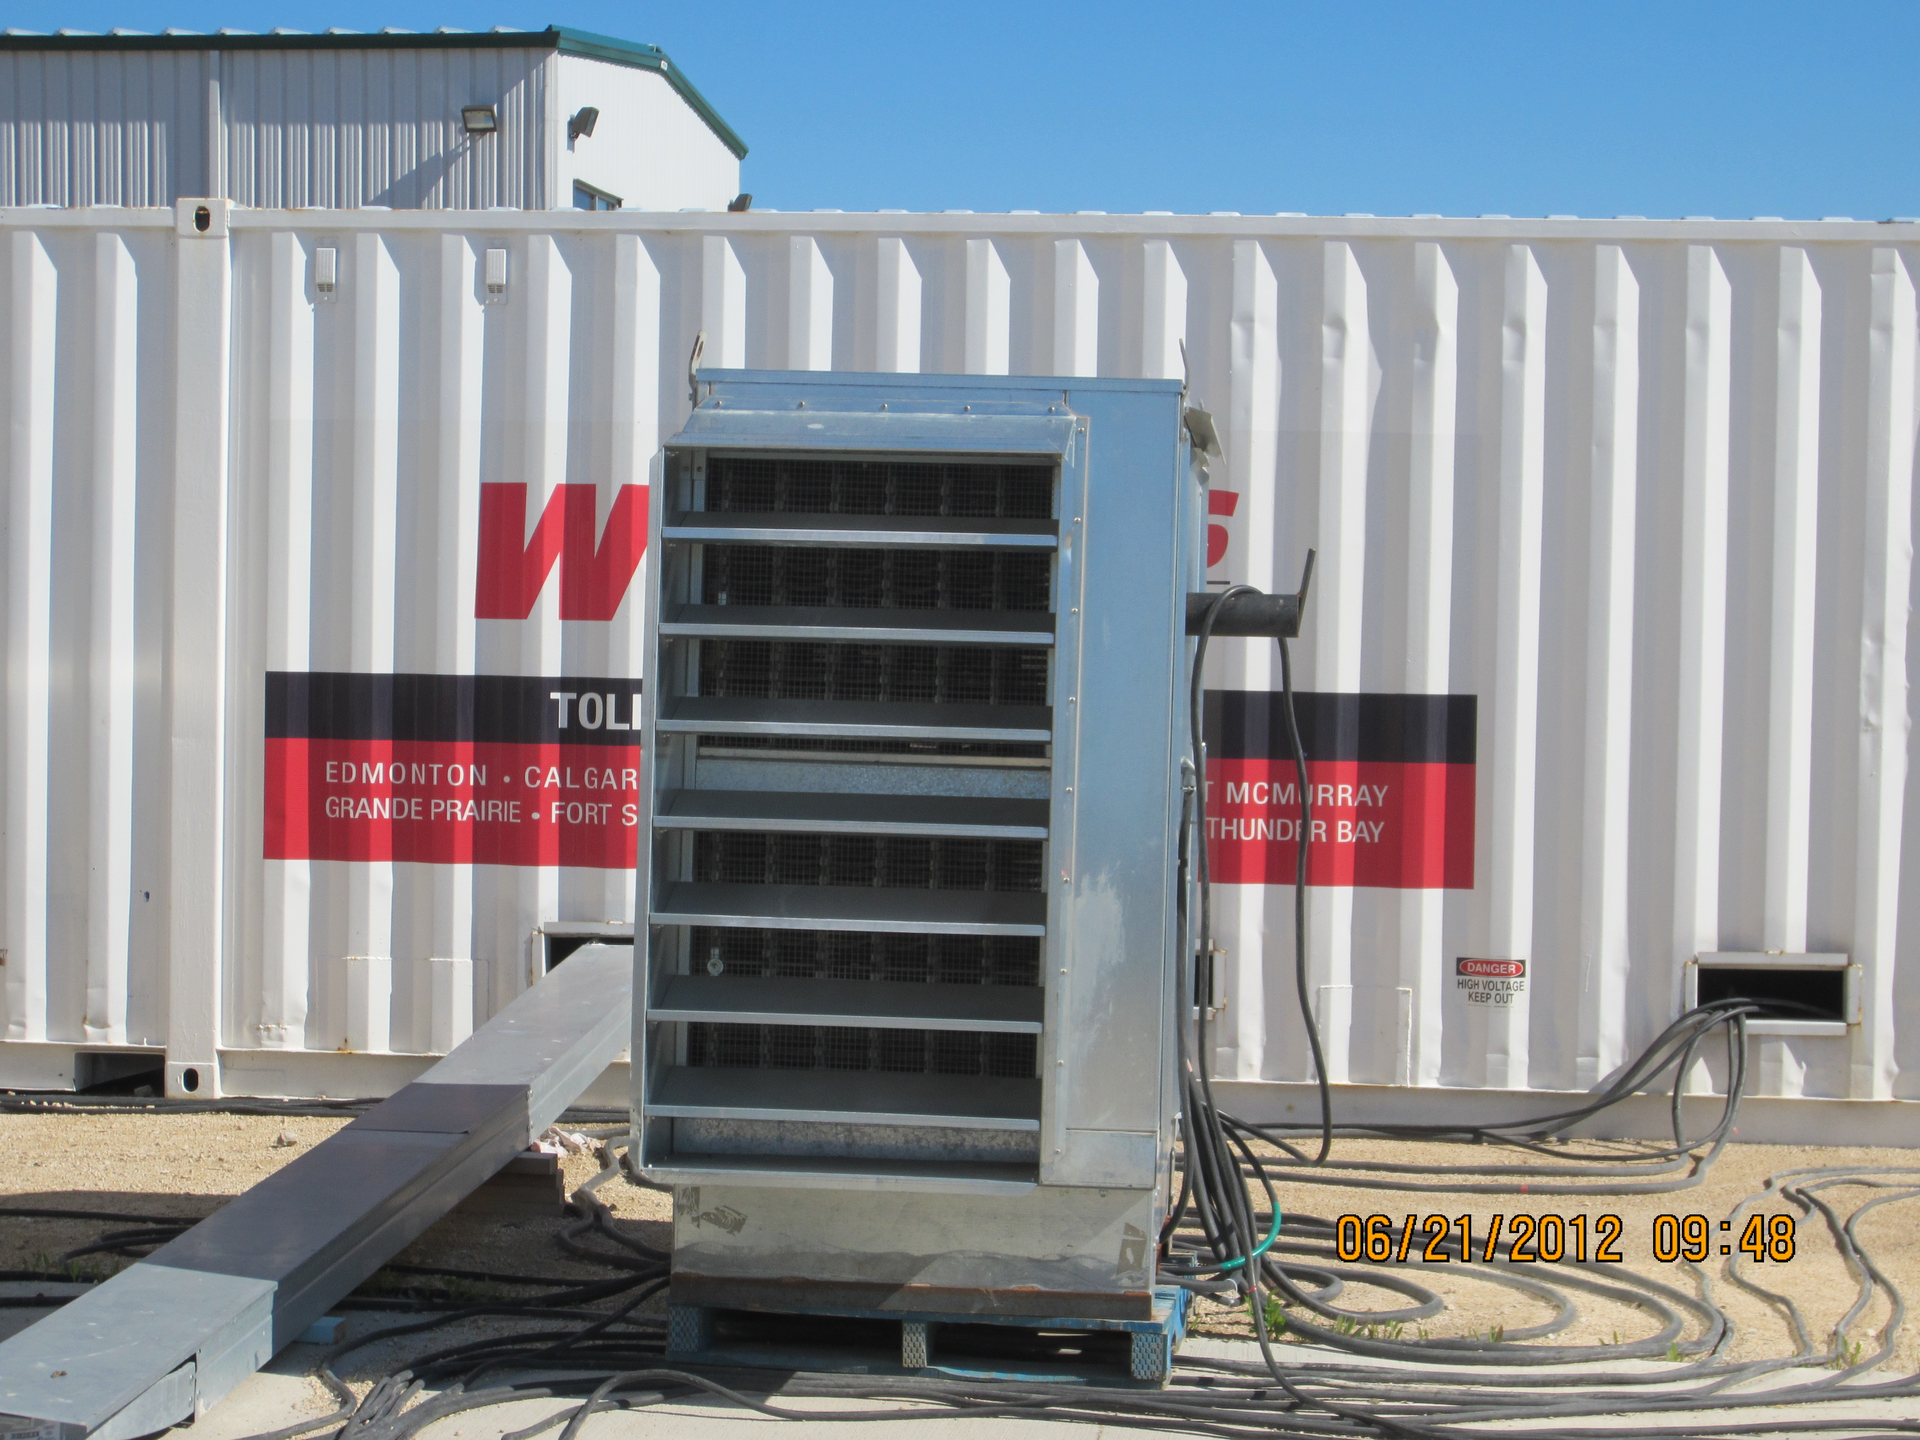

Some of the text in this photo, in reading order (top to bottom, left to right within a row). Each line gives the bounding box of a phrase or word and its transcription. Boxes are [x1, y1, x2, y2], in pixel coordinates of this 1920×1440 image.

[325, 761, 638, 790] EDMONTON CALGAR
[325, 797, 423, 821] GRANDE
[431, 799, 521, 824] PRAIRIE
[551, 802, 612, 825] FORT
[1337, 820, 1385, 843] BAY
[1467, 962, 1516, 974] DANGER
[1457, 979, 1525, 992] HIGH VOLTAGE
[1468, 991, 1514, 1004] KEEP OUT
